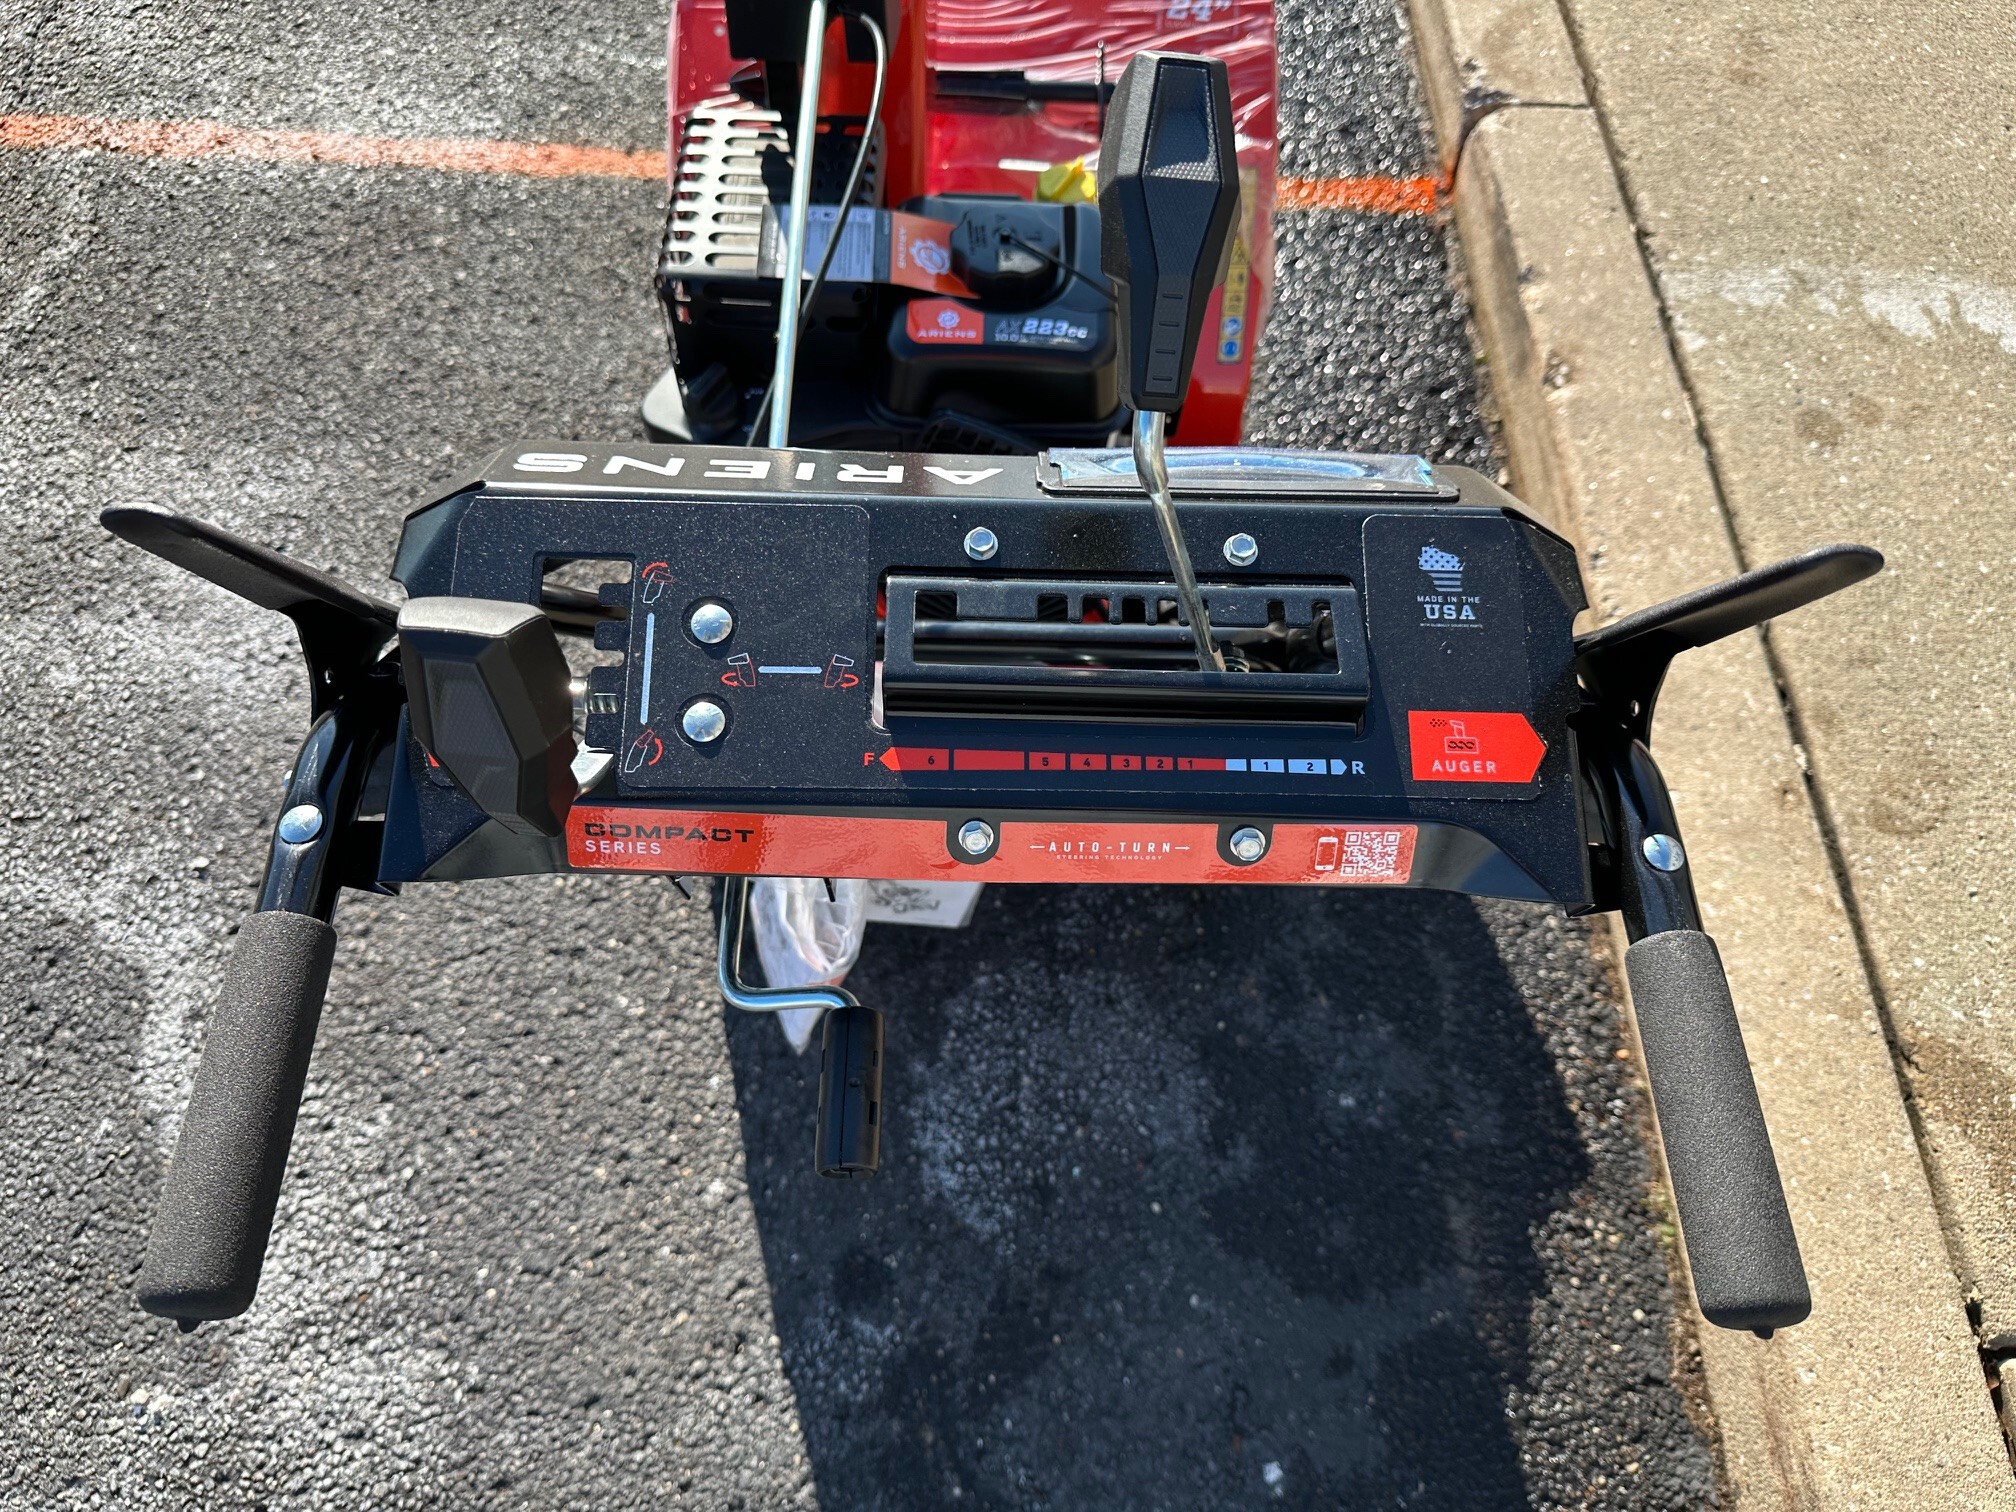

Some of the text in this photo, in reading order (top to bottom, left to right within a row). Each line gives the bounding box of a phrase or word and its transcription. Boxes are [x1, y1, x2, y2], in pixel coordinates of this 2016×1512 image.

[896, 224, 908, 269] ARIENS
[917, 328, 977, 339] ARIENS
[1022, 317, 1089, 339] 223cc
[513, 452, 1004, 485] ARIENS
[1424, 604, 1475, 619] USA
[864, 753, 874, 766] F
[927, 755, 935, 766] 6
[1041, 756, 1049, 767] 5
[1082, 757, 1091, 767] 4
[1121, 757, 1129, 768] 3
[1157, 758, 1165, 768] 2
[1187, 758, 1193, 768] 1
[1263, 761, 1269, 771] 1
[1306, 762, 1314, 772] 2
[1352, 761, 1365, 774] R
[1432, 760, 1496, 773] AUGER
[584, 823, 754, 842] COMPACT
[585, 841, 661, 855] SERIES
[1048, 841, 1171, 853] AUTO-TURN
